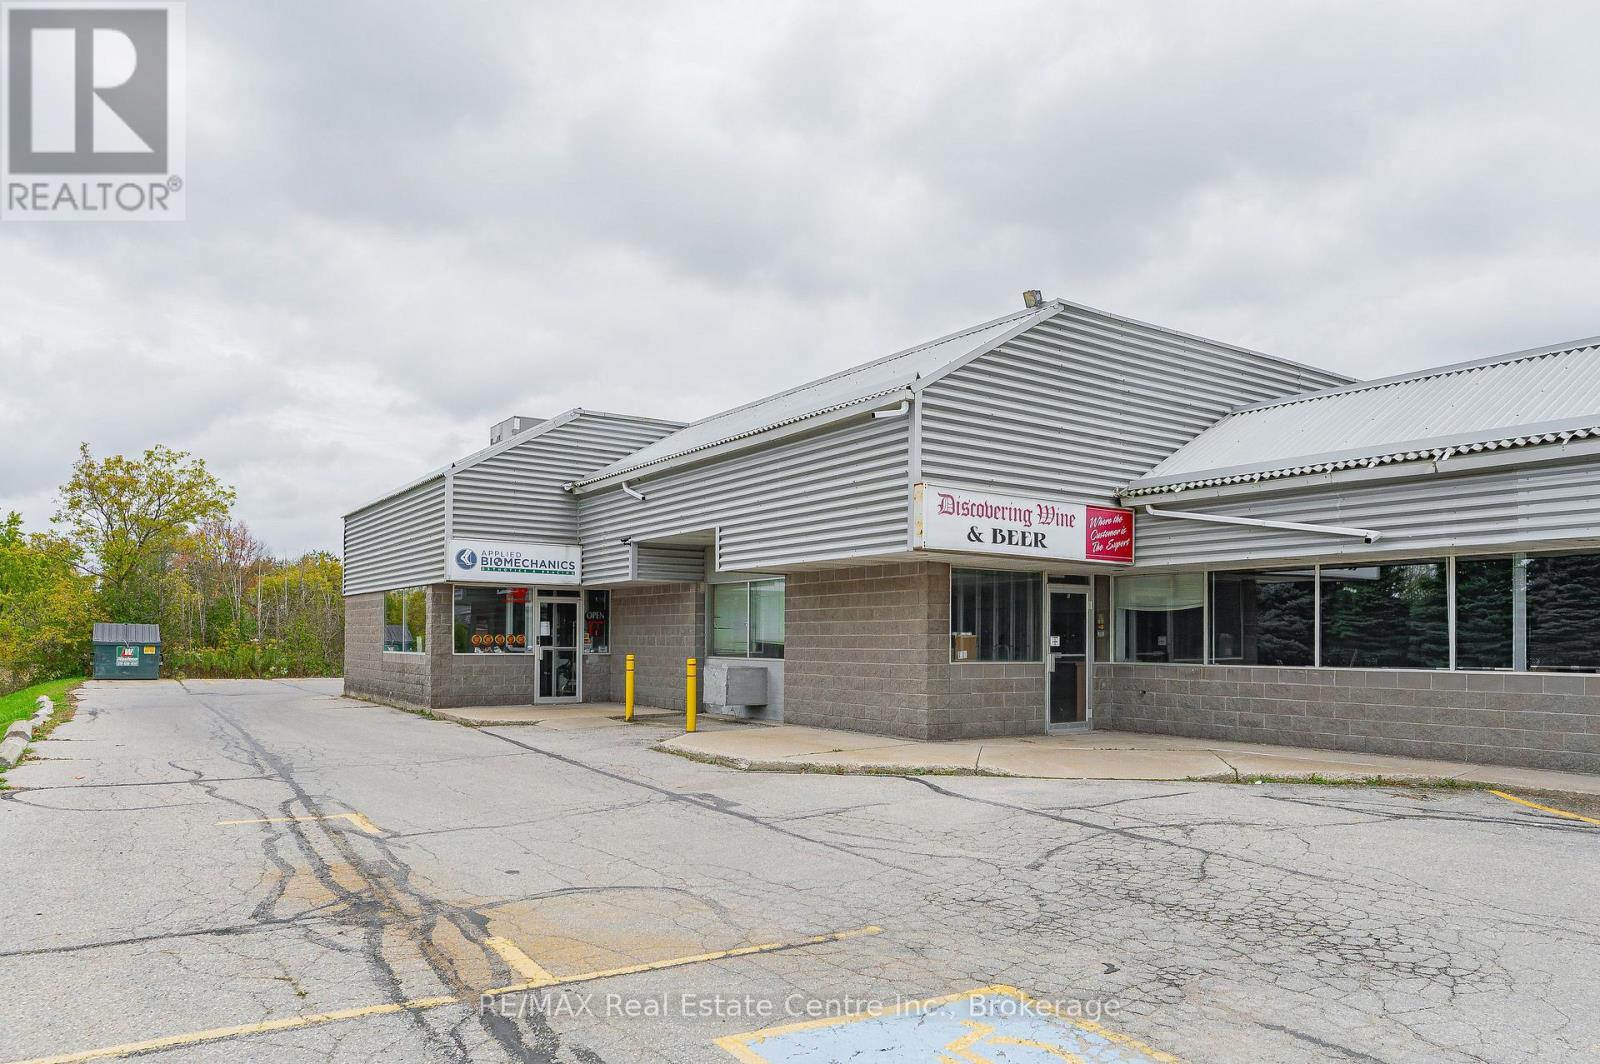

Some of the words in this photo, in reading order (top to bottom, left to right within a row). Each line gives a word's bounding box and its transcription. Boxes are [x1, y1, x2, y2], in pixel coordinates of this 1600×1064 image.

[937, 492, 1033, 527] Discovering
[1037, 503, 1076, 528] Wine
[1090, 516, 1112, 528] Where
[1112, 514, 1124, 524] the
[966, 525, 984, 543] &
[991, 527, 1048, 549] BEER
[1090, 529, 1121, 541] Customer
[1120, 526, 1127, 535] is
[1092, 541, 1104, 552] The
[1105, 538, 1131, 552] Expert
[481, 557, 575, 570] BIOMECHANICS
[586, 611, 605, 620] OPEN
